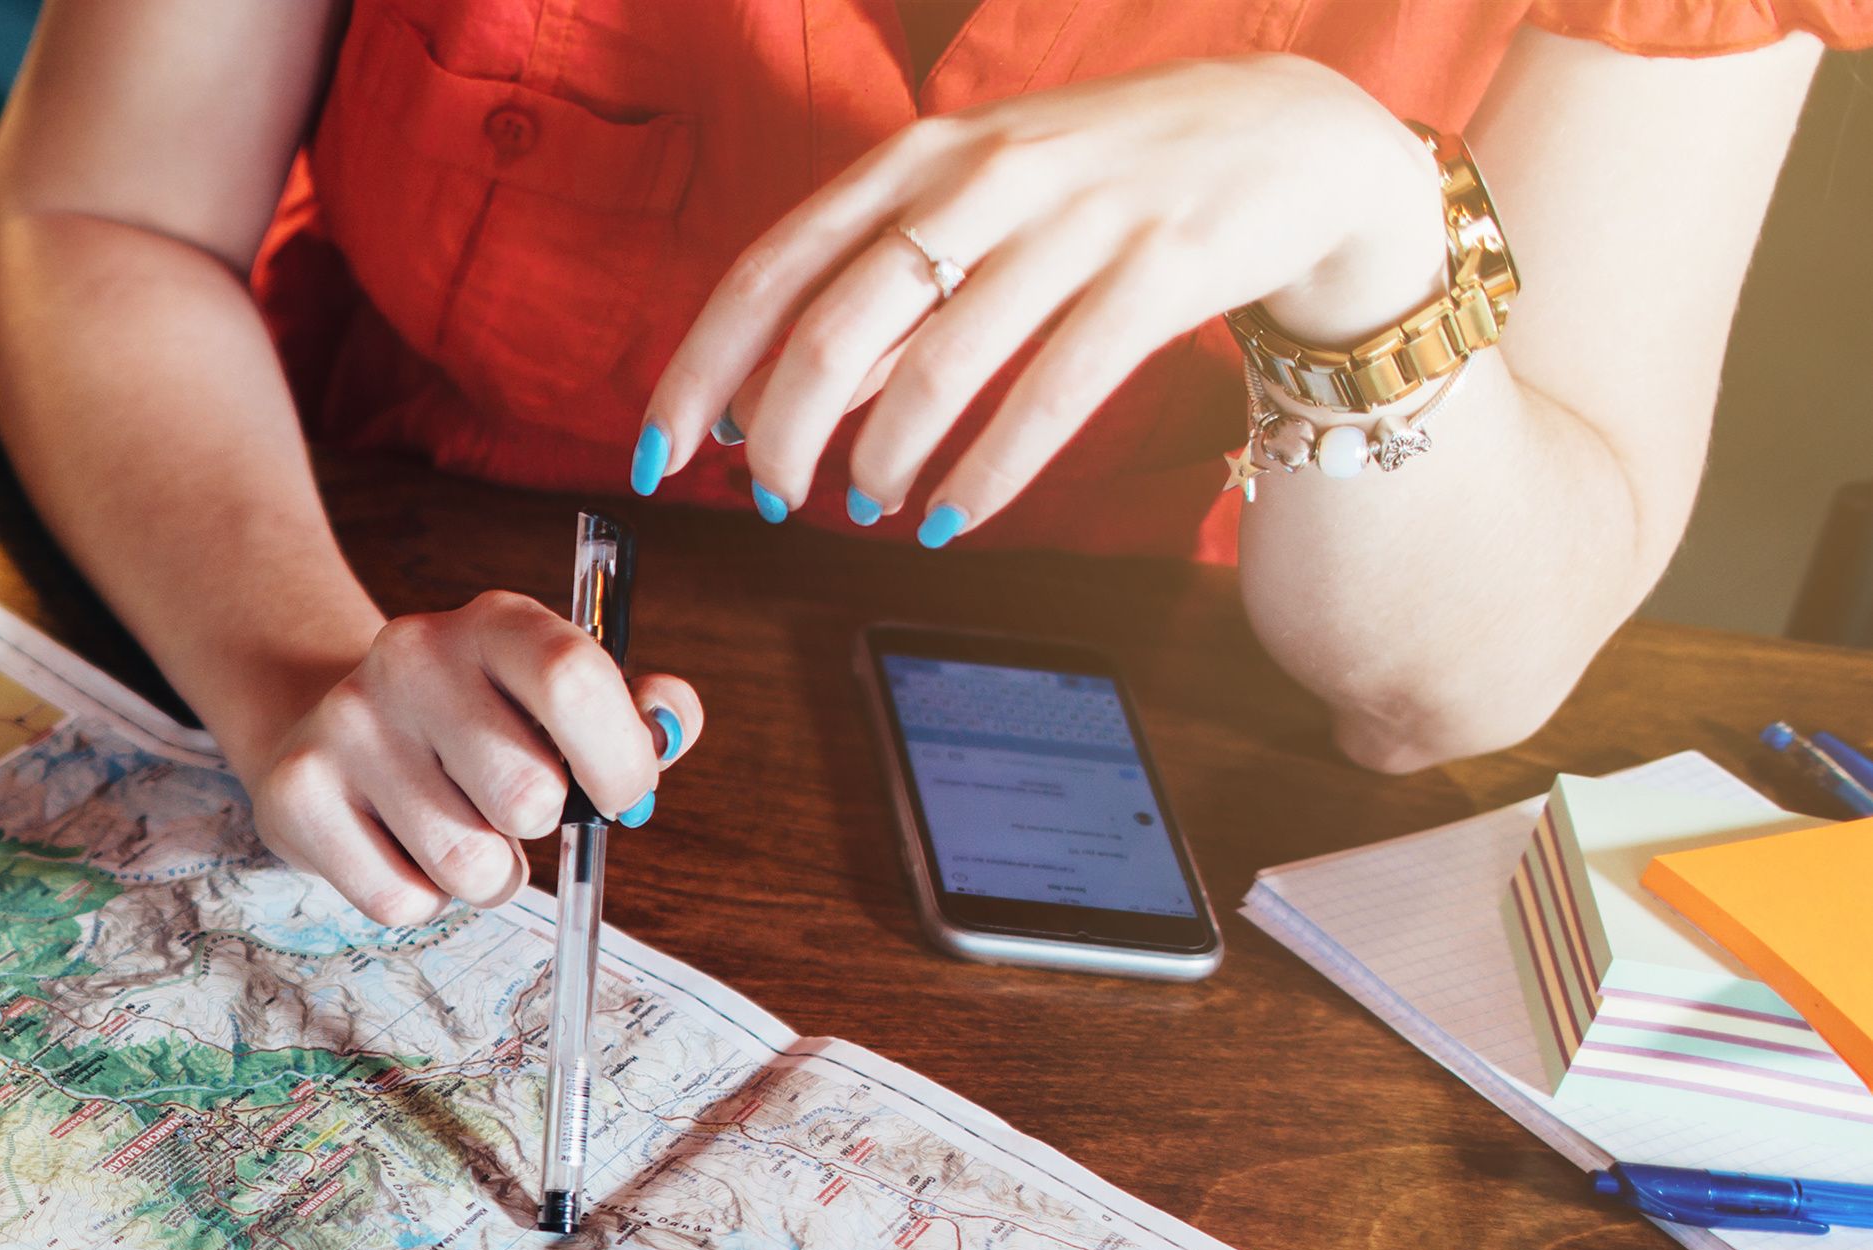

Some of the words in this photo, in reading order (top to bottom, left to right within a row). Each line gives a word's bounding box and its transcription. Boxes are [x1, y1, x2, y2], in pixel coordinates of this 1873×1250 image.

[80, 1098, 103, 1117] Larja
[262, 1101, 314, 1143] SYANGBOCHE
[360, 1111, 385, 1132] Mende
[52, 1113, 83, 1138] Dobhan
[138, 1113, 182, 1149] NAMCHE
[104, 1144, 141, 1174] BAZAR
[320, 1144, 355, 1174] KHUNDE
[296, 1179, 342, 1217] KHUMJUNG
[392, 1182, 420, 1223] Danda
